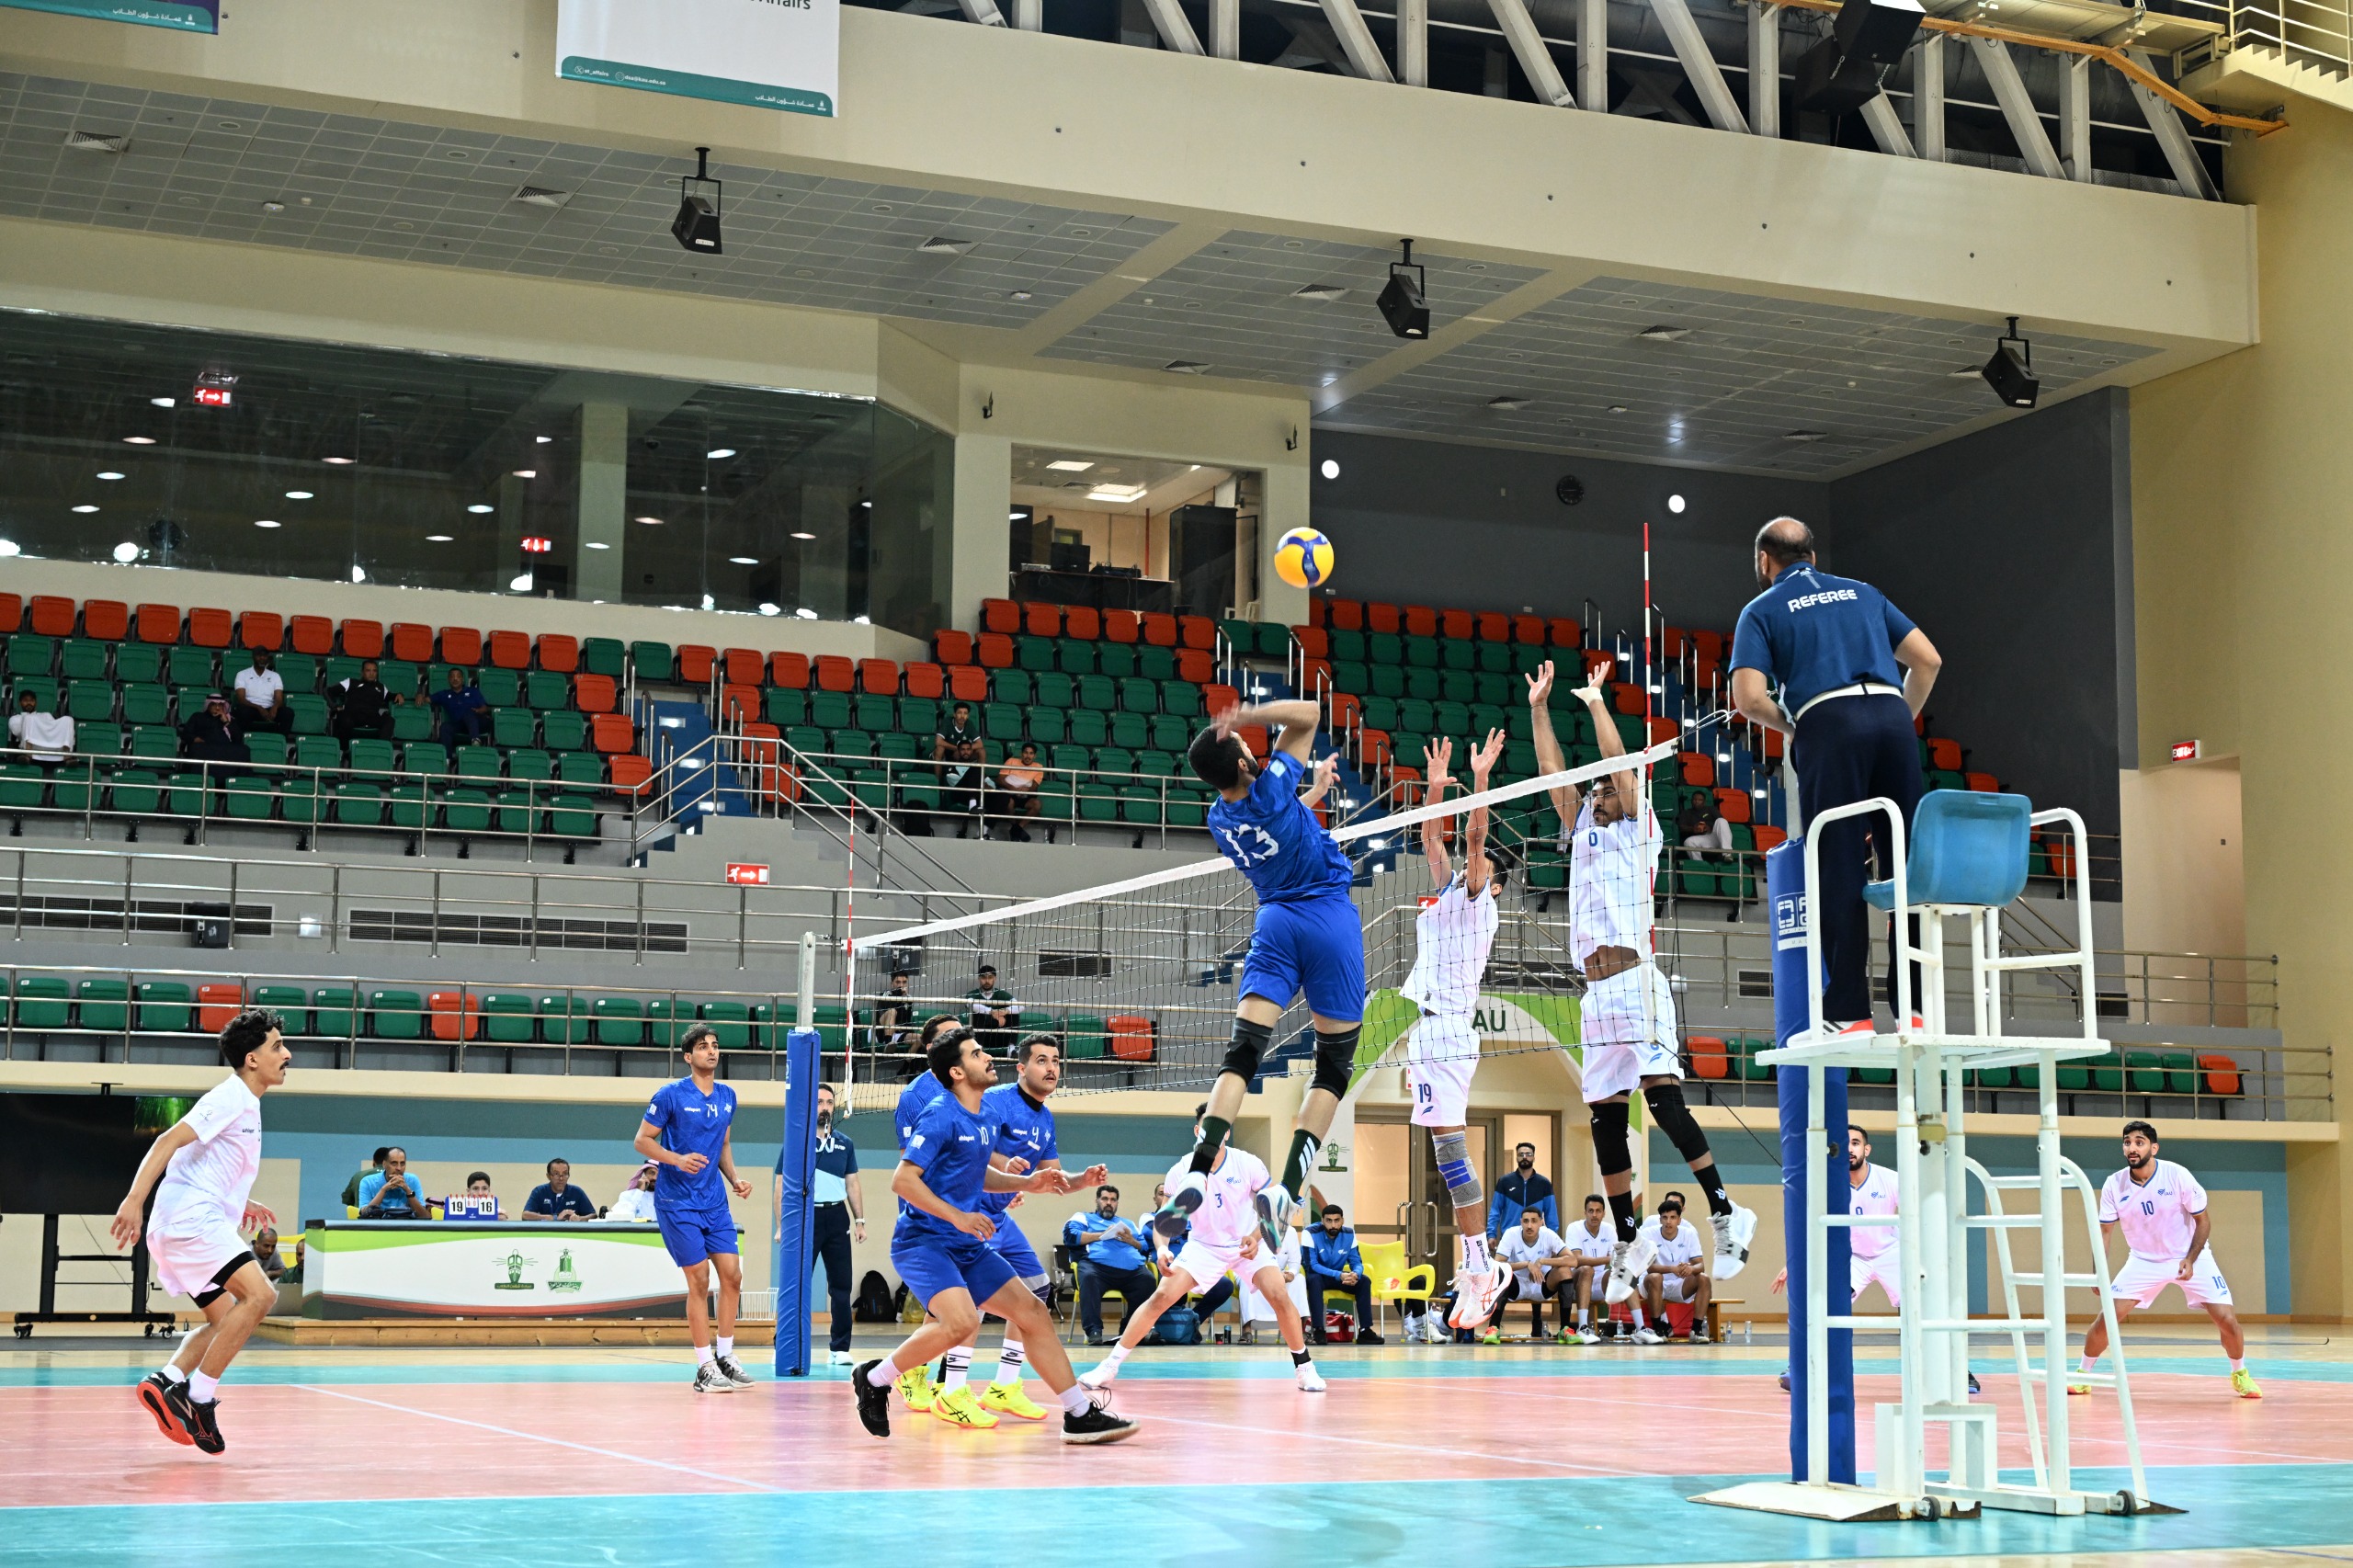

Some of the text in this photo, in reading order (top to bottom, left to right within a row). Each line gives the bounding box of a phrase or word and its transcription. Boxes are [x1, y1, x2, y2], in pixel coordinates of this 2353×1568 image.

[1787, 589, 1858, 613] REFEREE
[1216, 824, 1279, 868] 13
[1417, 1083, 1432, 1104] 19
[1031, 1126, 1040, 1143] 4
[451, 1200, 463, 1212] 19
[481, 1201, 493, 1213] 16
[1214, 1192, 1222, 1209] 3
[2141, 1200, 2154, 1216] 10
[2211, 1276, 2226, 1290] 10
